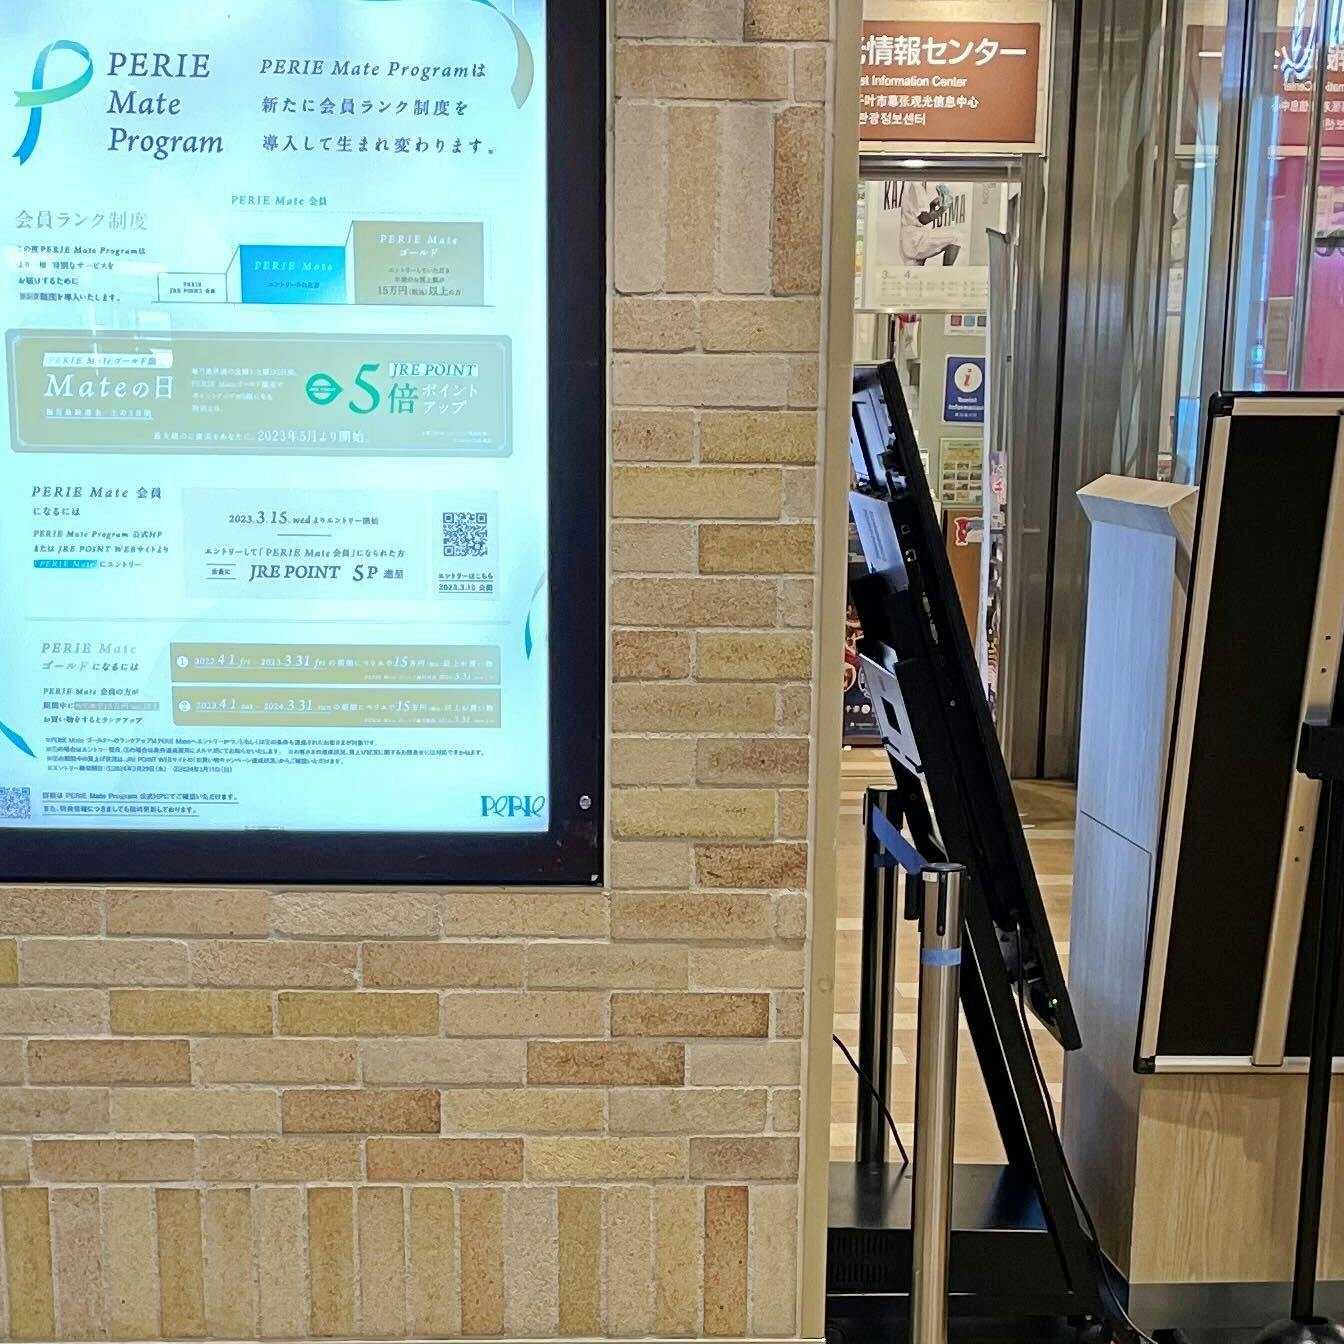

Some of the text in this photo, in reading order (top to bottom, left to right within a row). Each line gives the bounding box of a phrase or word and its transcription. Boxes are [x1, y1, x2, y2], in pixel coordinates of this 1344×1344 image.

[106, 52, 211, 78] PERIE
[259, 59, 486, 82] PERIE Mate Programは
[871, 75, 930, 87] Information
[931, 75, 968, 87] Center
[106, 89, 182, 116] Mate
[261, 95, 468, 117] 新たに会員ランク制度を
[107, 127, 224, 160] Program
[262, 134, 495, 155] 導入して生まれ変わります。
[231, 195, 270, 206] PERIE
[274, 195, 305, 206] Mate
[15, 208, 149, 231] 会員ランク制度
[379, 234, 421, 244] PERIE
[254, 261, 296, 271] PERIE
[392, 362, 477, 377] JRE POINT
[43, 372, 173, 400] Mateの日
[422, 383, 478, 398] ポイント
[423, 400, 468, 415] アップ
[31, 486, 162, 499] PERIE Mate 会員
[33, 506, 81, 516] になるには
[248, 564, 281, 582] JRE
[284, 564, 341, 579] POINT
[41, 642, 137, 654] PERIE Mate
